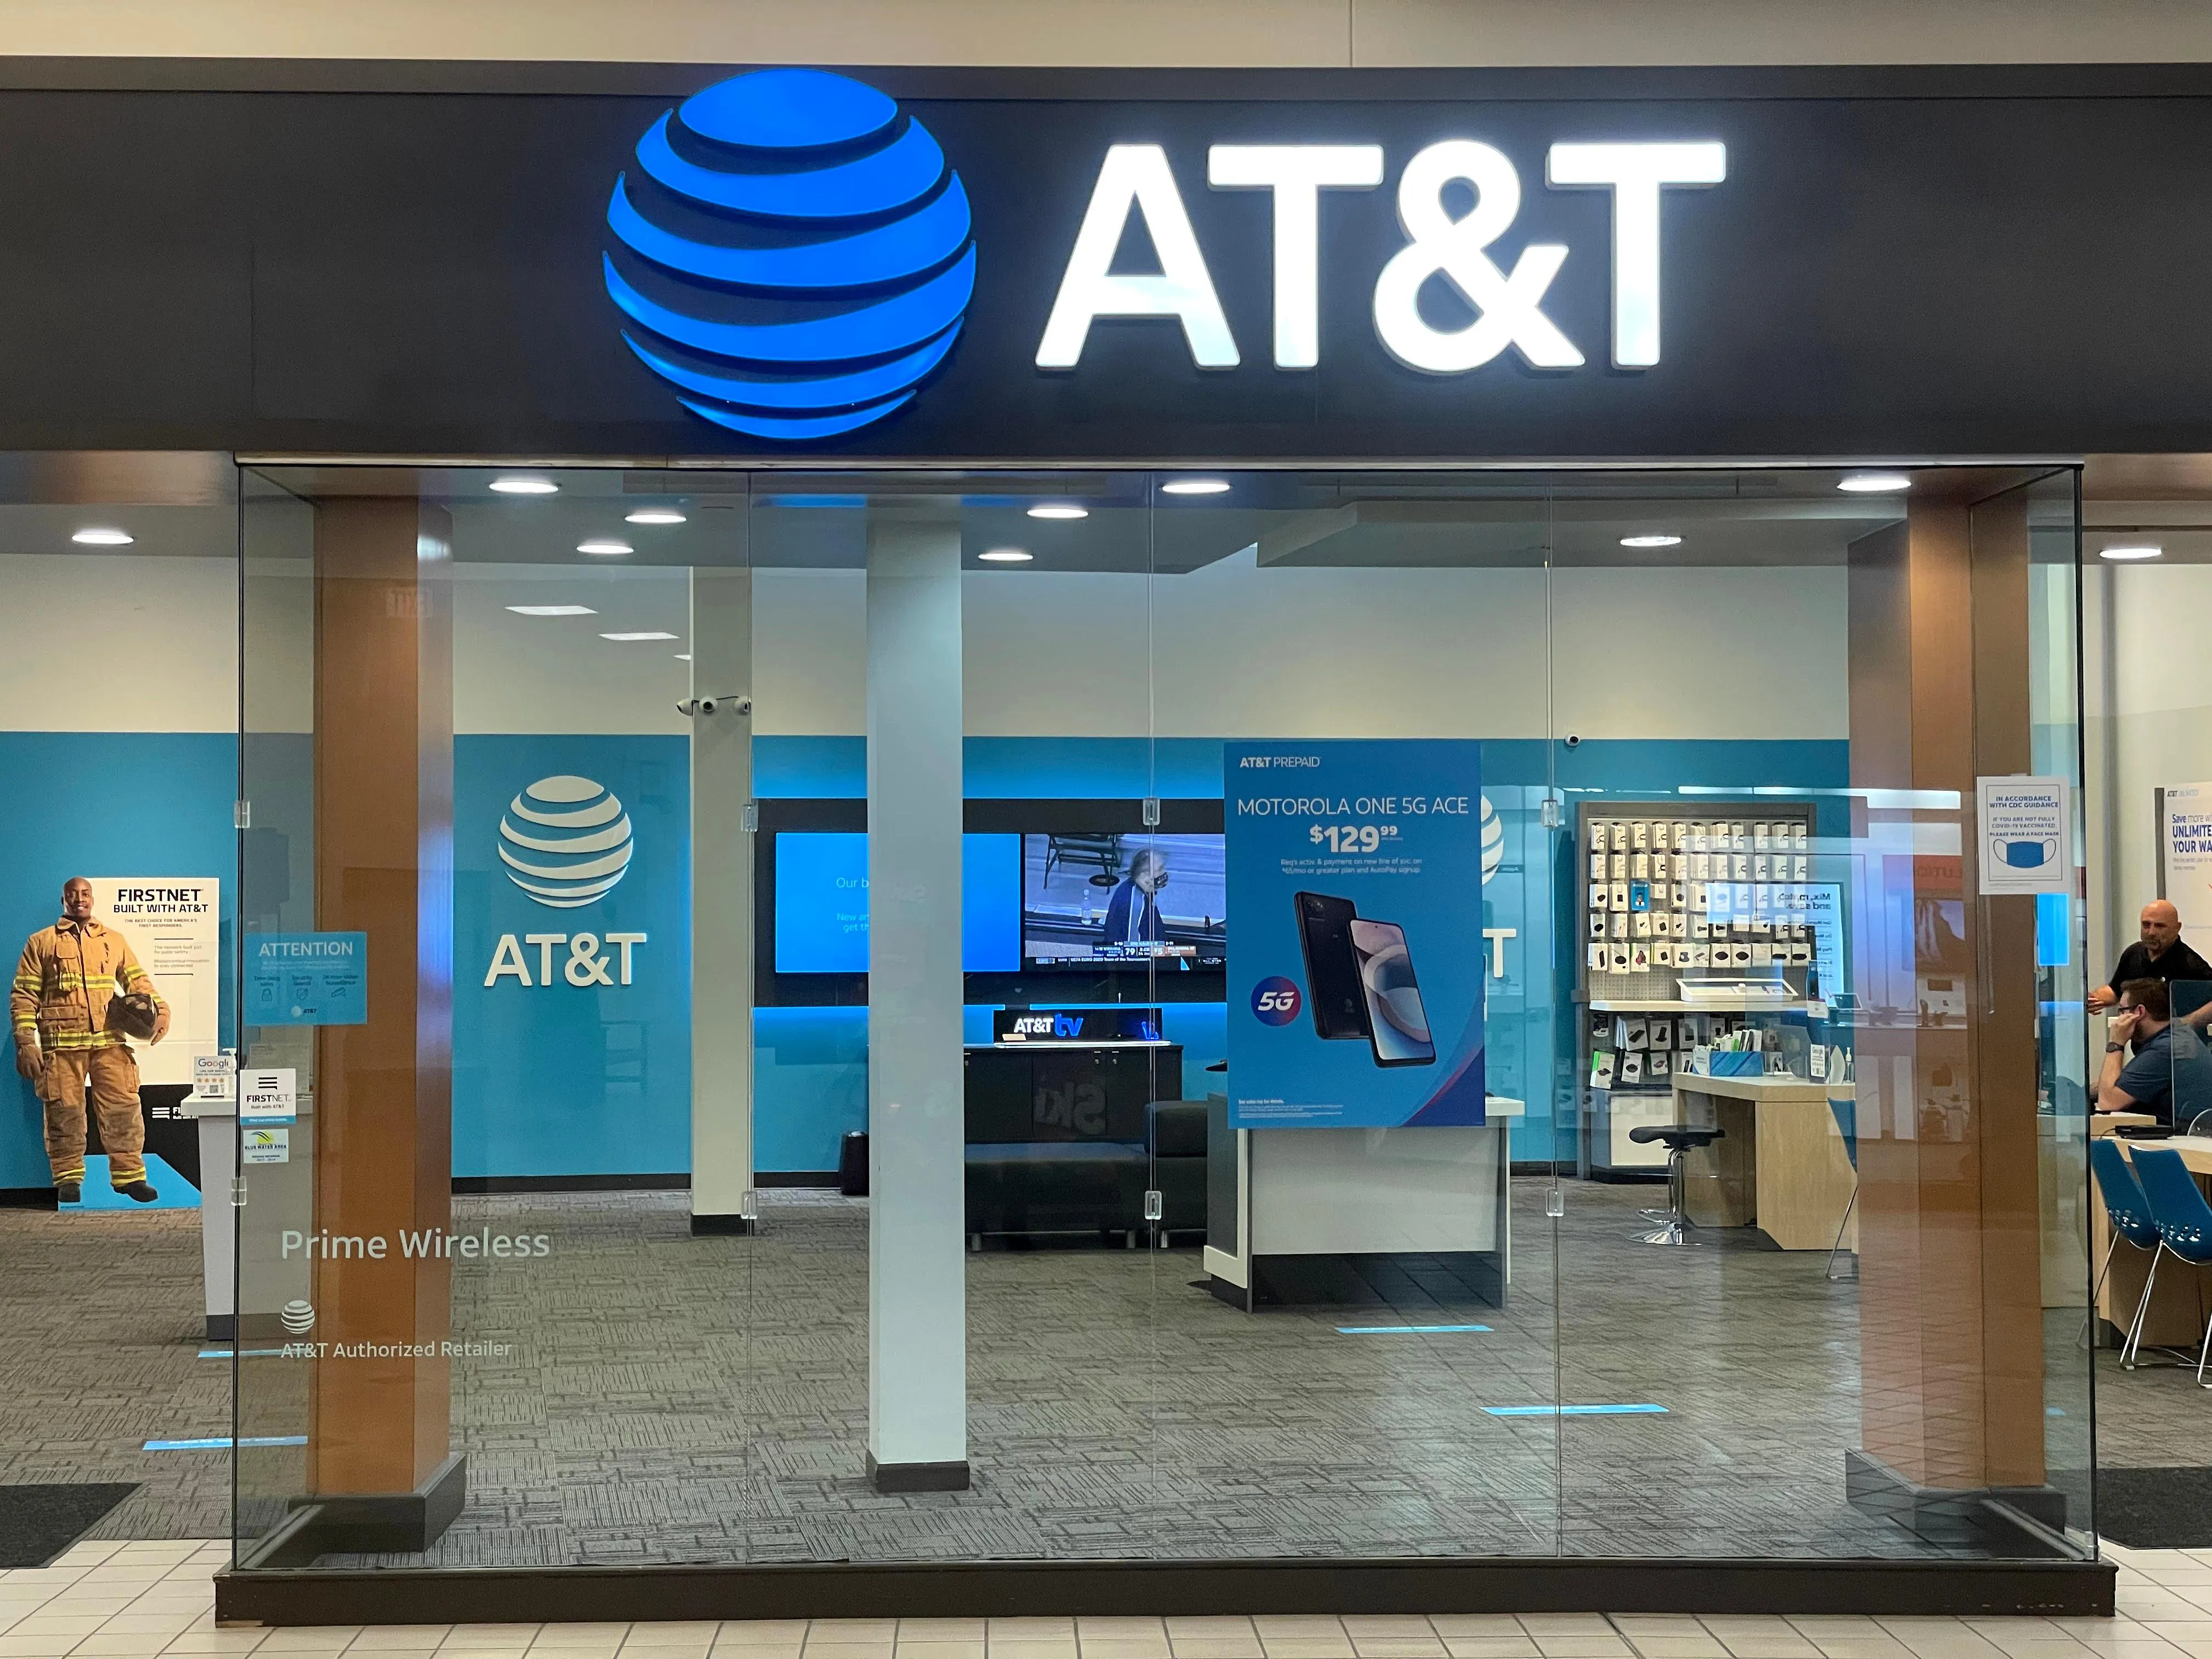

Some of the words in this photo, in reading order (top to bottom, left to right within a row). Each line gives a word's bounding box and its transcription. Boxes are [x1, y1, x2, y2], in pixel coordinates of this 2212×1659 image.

[1034, 138, 1726, 372] AT&T
[1239, 757, 1272, 768] AT&T
[1274, 757, 1321, 768] PREPAID
[1238, 798, 1351, 816] MOTOROLA
[1355, 797, 1397, 815] ONE
[1402, 797, 1426, 814] 5G
[1431, 797, 1469, 814] ACE
[2172, 814, 2186, 823] Save
[2188, 815, 2204, 823] more
[2172, 840, 2197, 854] YOUR
[836, 877, 858, 888] Our
[118, 889, 202, 901] FIRSTNET
[114, 904, 143, 913] BUILT
[147, 904, 176, 913] WITH
[179, 904, 208, 912] AT&T
[837, 913, 857, 921] New
[843, 924, 858, 933] get
[259, 941, 353, 957] ATTENTION
[1125, 947, 1136, 956] 79
[484, 933, 647, 987] AT&T
[1257, 991, 1295, 1012] 5G
[1014, 1018, 1054, 1033] AT&T
[1054, 1014, 1084, 1036] tv
[246, 1094, 289, 1102] FIRSTNET
[281, 1228, 387, 1260] Prime
[399, 1227, 550, 1259] Wireless
[280, 1342, 329, 1358] AT&T
[333, 1341, 435, 1357] Authorized
[441, 1340, 512, 1356] Retailer
